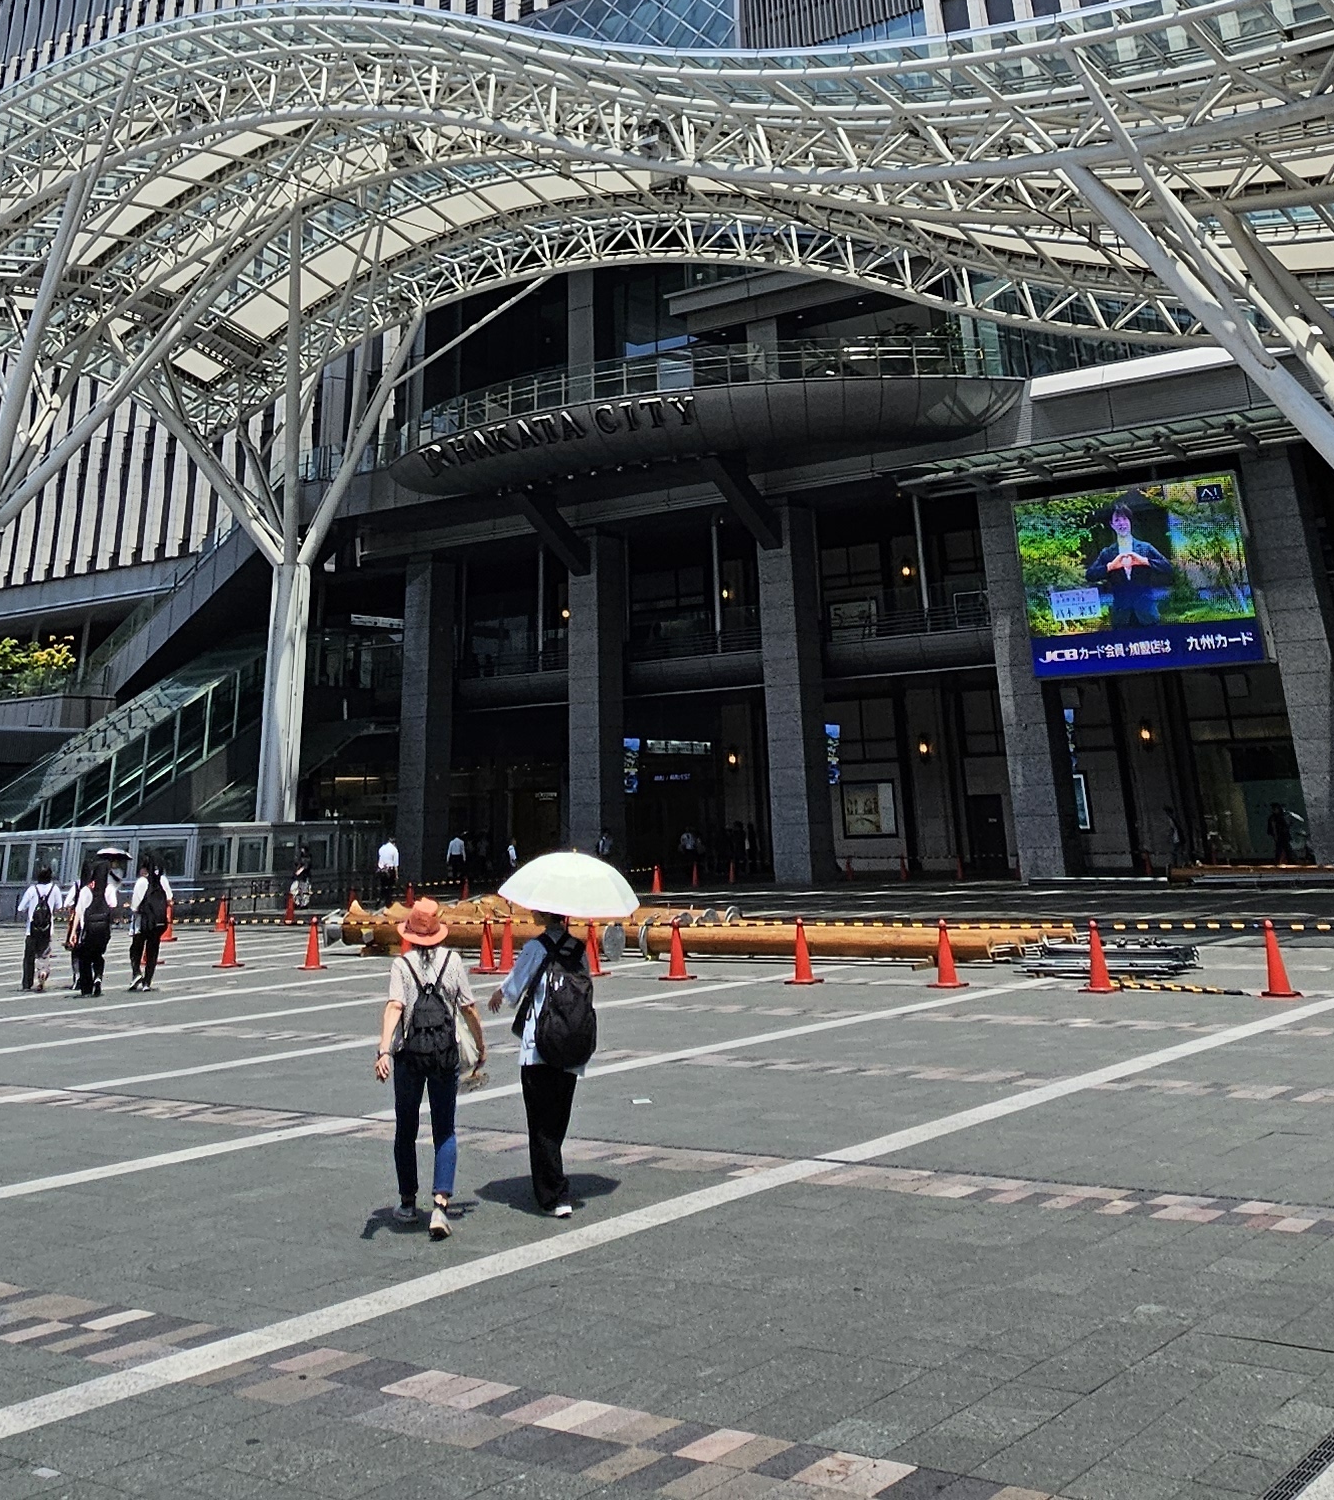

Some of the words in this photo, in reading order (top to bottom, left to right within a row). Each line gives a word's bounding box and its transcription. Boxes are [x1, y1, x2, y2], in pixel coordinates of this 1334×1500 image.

[594, 396, 694, 435] CITY
[1186, 631, 1254, 652] 九州カード
